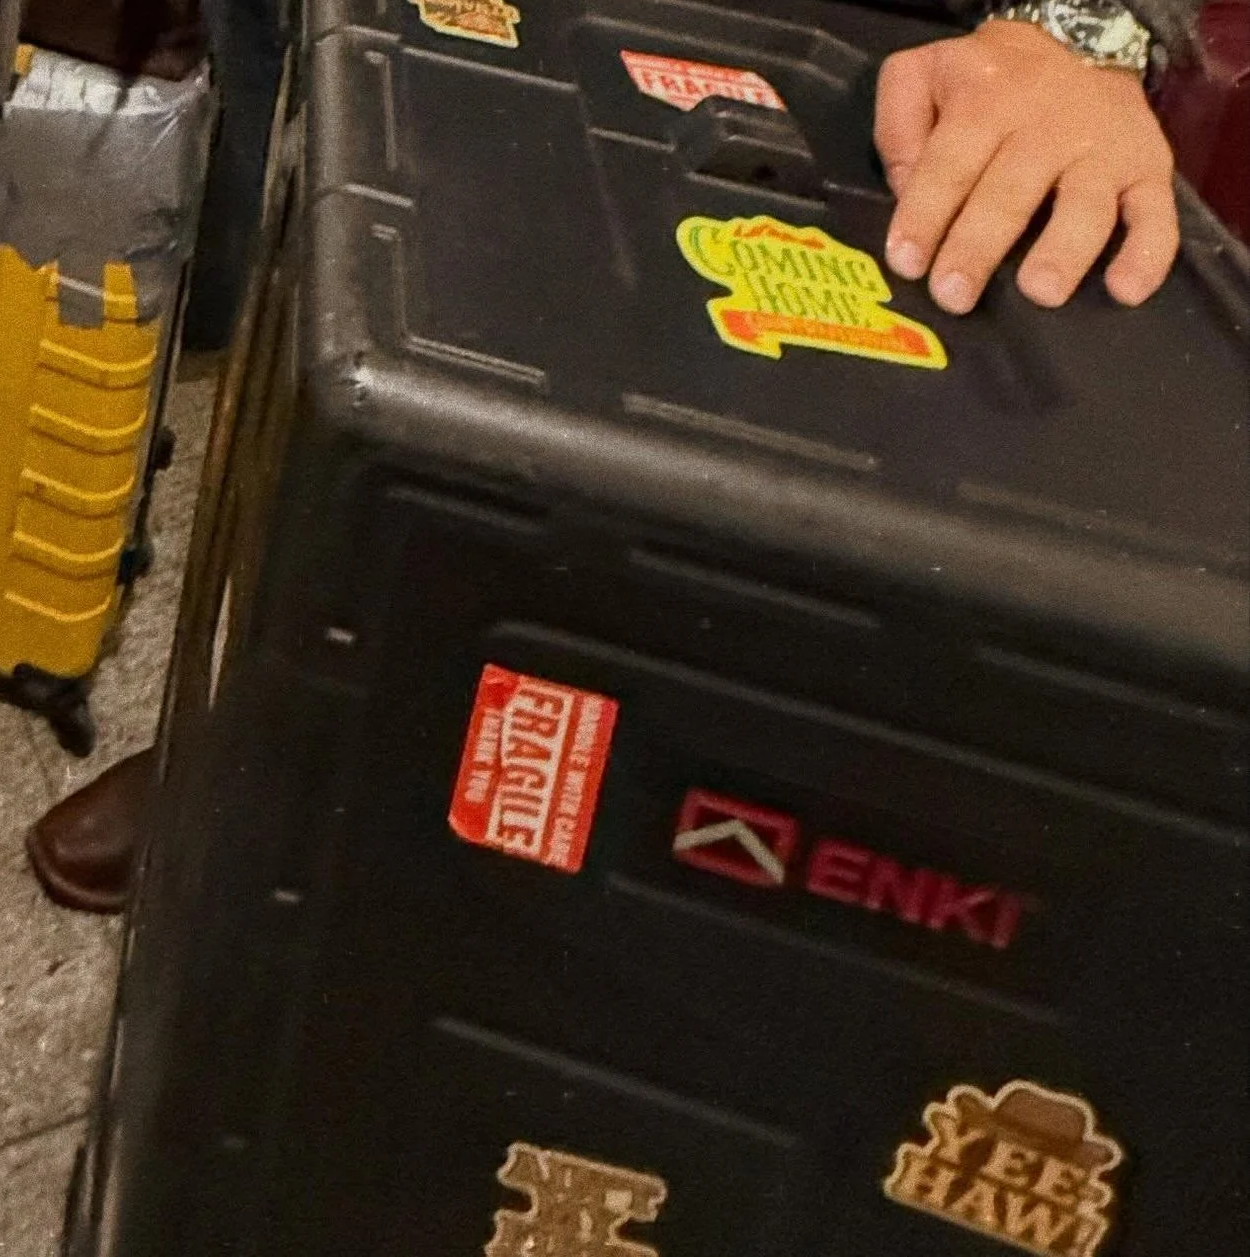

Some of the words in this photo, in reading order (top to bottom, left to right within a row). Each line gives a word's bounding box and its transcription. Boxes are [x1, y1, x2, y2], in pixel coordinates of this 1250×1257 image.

[688, 224, 880, 293] COMING
[743, 270, 873, 328] HOME
[497, 688, 565, 849] FRAGILE
[806, 838, 1022, 950] ENKI
[930, 1109, 1086, 1208] YEE
